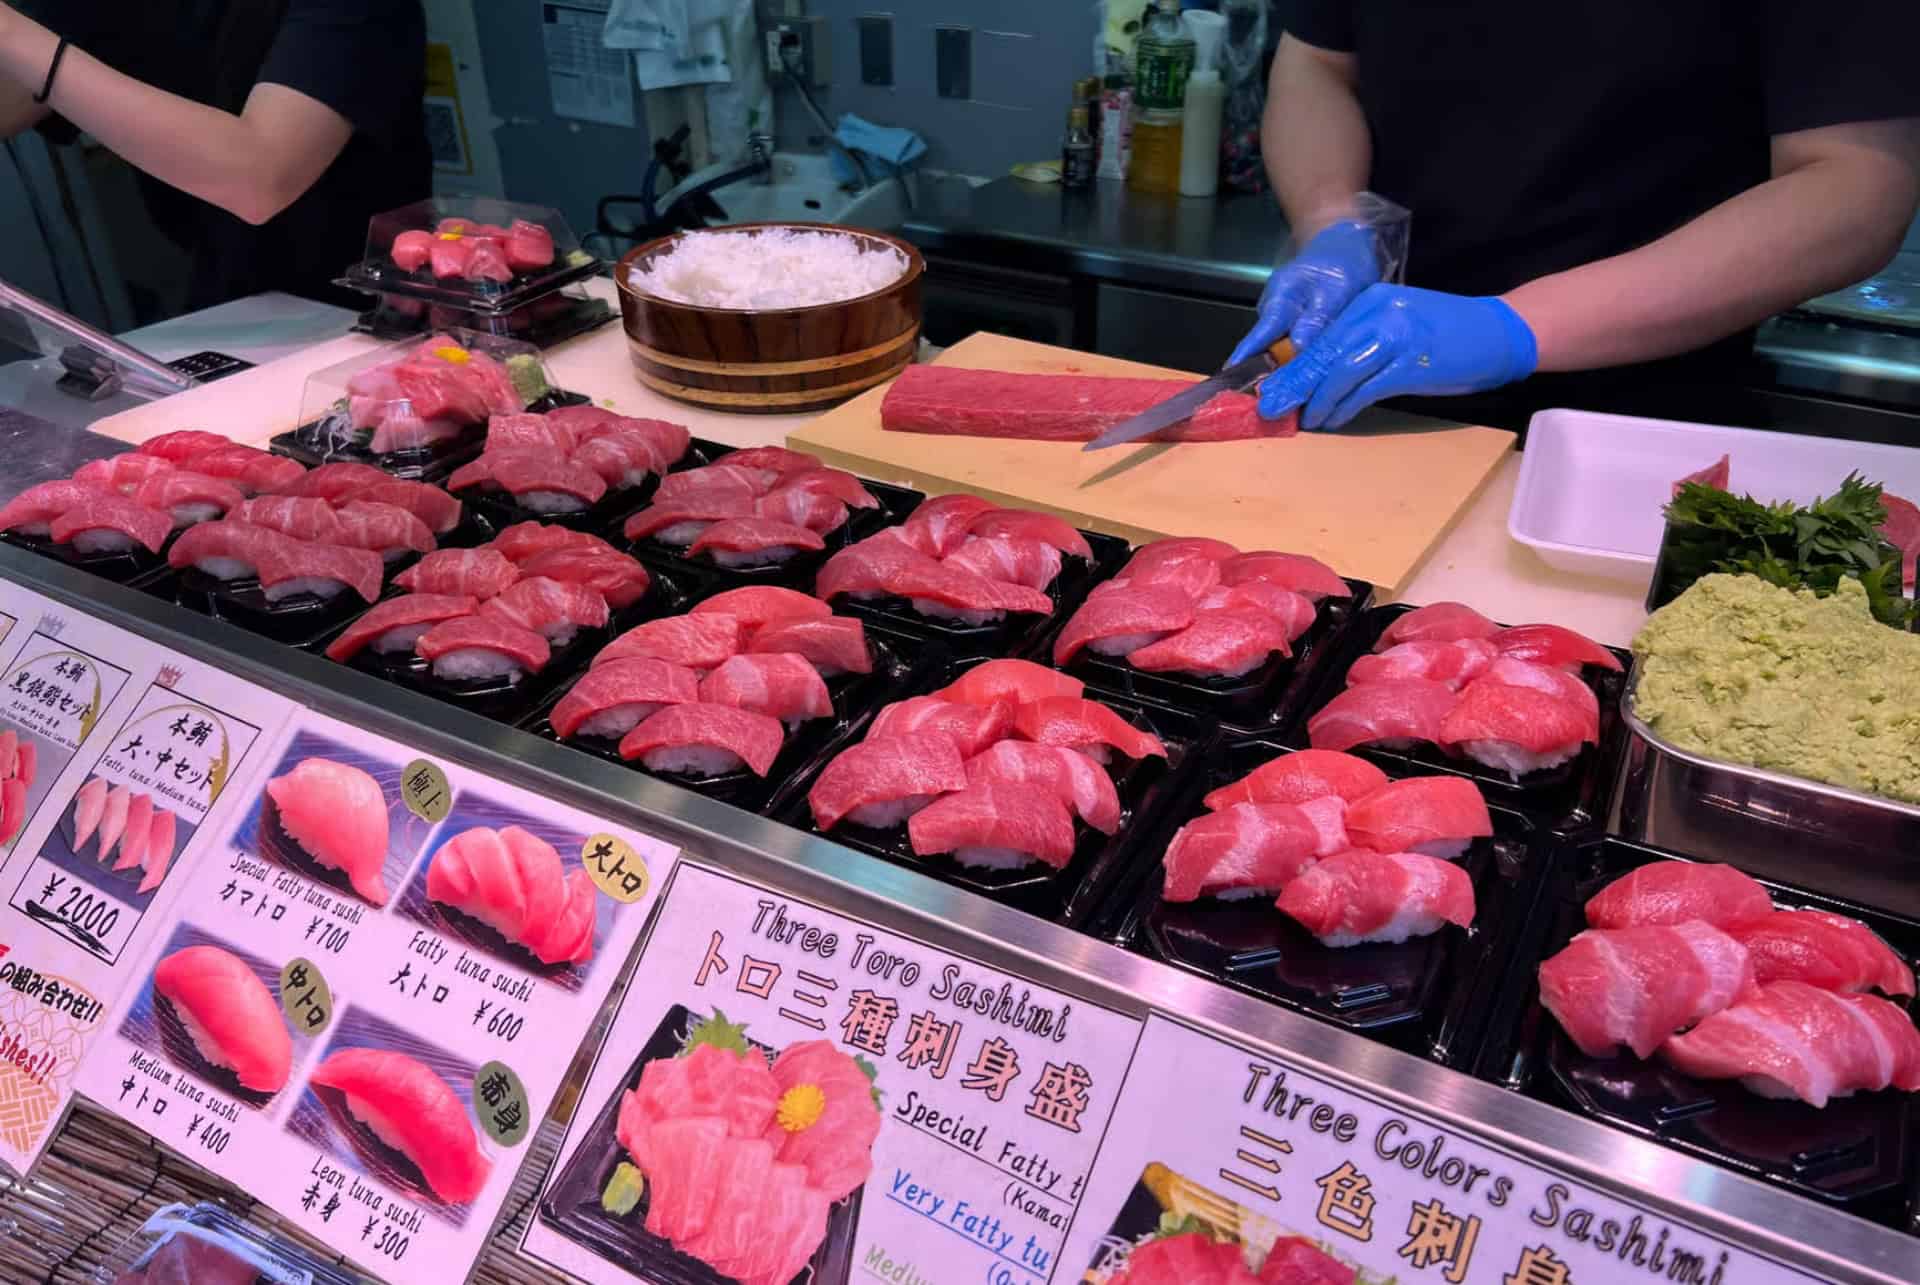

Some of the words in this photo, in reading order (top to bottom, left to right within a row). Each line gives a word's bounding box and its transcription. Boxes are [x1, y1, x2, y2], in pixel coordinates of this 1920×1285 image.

[230, 852, 272, 882] Special
[272, 871, 305, 899] Fatty
[304, 885, 332, 911] tuna
[332, 901, 366, 925] sushi
[586, 840, 642, 895] 大トロ
[40, 872, 119, 938] ¥2000
[220, 880, 287, 921] カマトロ
[304, 915, 350, 953] ¥700
[408, 930, 448, 965] Fatty
[454, 951, 491, 983] tuna
[492, 974, 536, 1002] sushi
[284, 963, 326, 1028] 中トロ
[389, 962, 449, 1003] 大トロ
[752, 900, 839, 958] Three
[850, 933, 921, 988] Toro
[930, 964, 1071, 1043] Sashimi
[472, 999, 524, 1042] ¥600
[694, 929, 1093, 1133] トロ三種刺身盛
[119, 1074, 168, 1115] 中トロ
[128, 1050, 172, 1085] Medium
[173, 1074, 204, 1103] tuna
[205, 1097, 241, 1123] sushi
[186, 1113, 231, 1154] ¥400
[896, 1090, 989, 1152] Special
[998, 1141, 1062, 1190] Fatty
[301, 1181, 341, 1223] 赤身
[311, 1155, 346, 1190] Lean
[348, 1175, 383, 1210] tuna
[384, 1203, 425, 1234] sushi
[1244, 1063, 1358, 1142] Three
[1375, 1119, 1513, 1207] Colors
[1529, 1184, 1729, 1285] Sashimi
[361, 1215, 409, 1261] ¥300
[892, 1168, 945, 1216] Very
[950, 1202, 1014, 1253] Fatty
